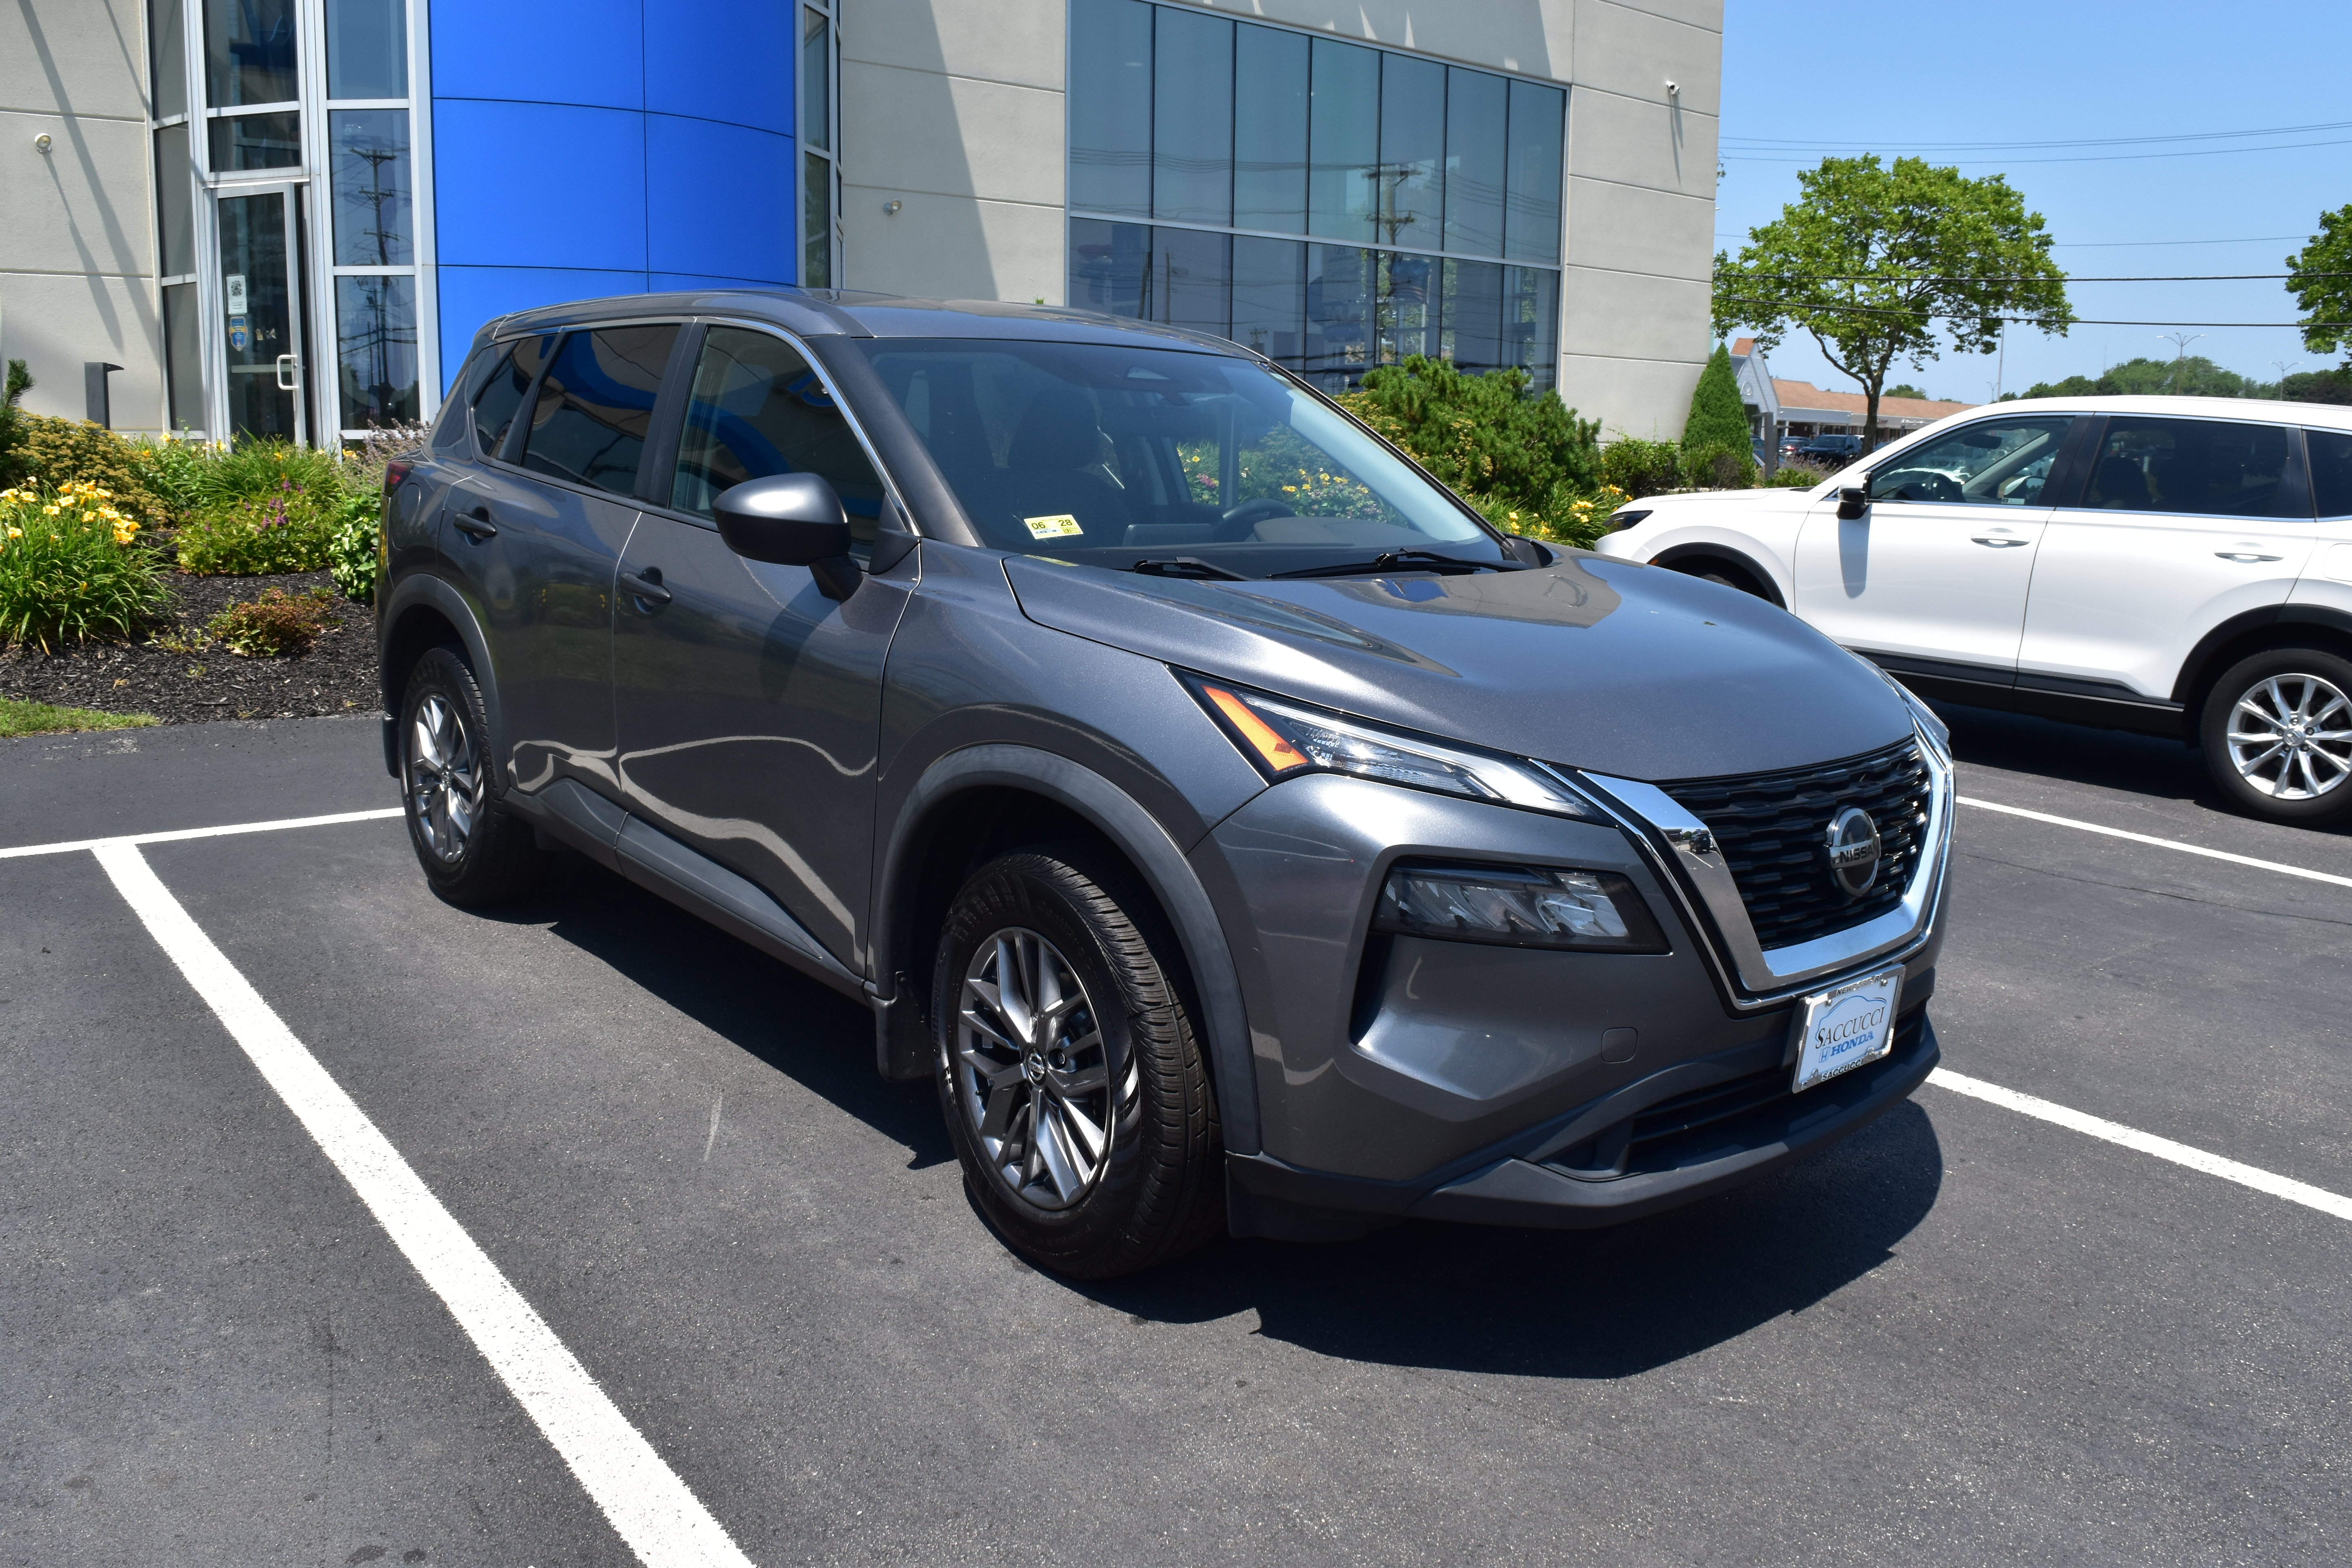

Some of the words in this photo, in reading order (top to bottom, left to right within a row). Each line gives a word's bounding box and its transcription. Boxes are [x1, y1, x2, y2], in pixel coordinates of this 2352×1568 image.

[1840, 844, 1876, 863] NISSAN
[1815, 1007, 1885, 1049] SACCUCCI
[1831, 1031, 1874, 1056] HONDA
[1821, 1057, 1864, 1082] SACCUCCI
